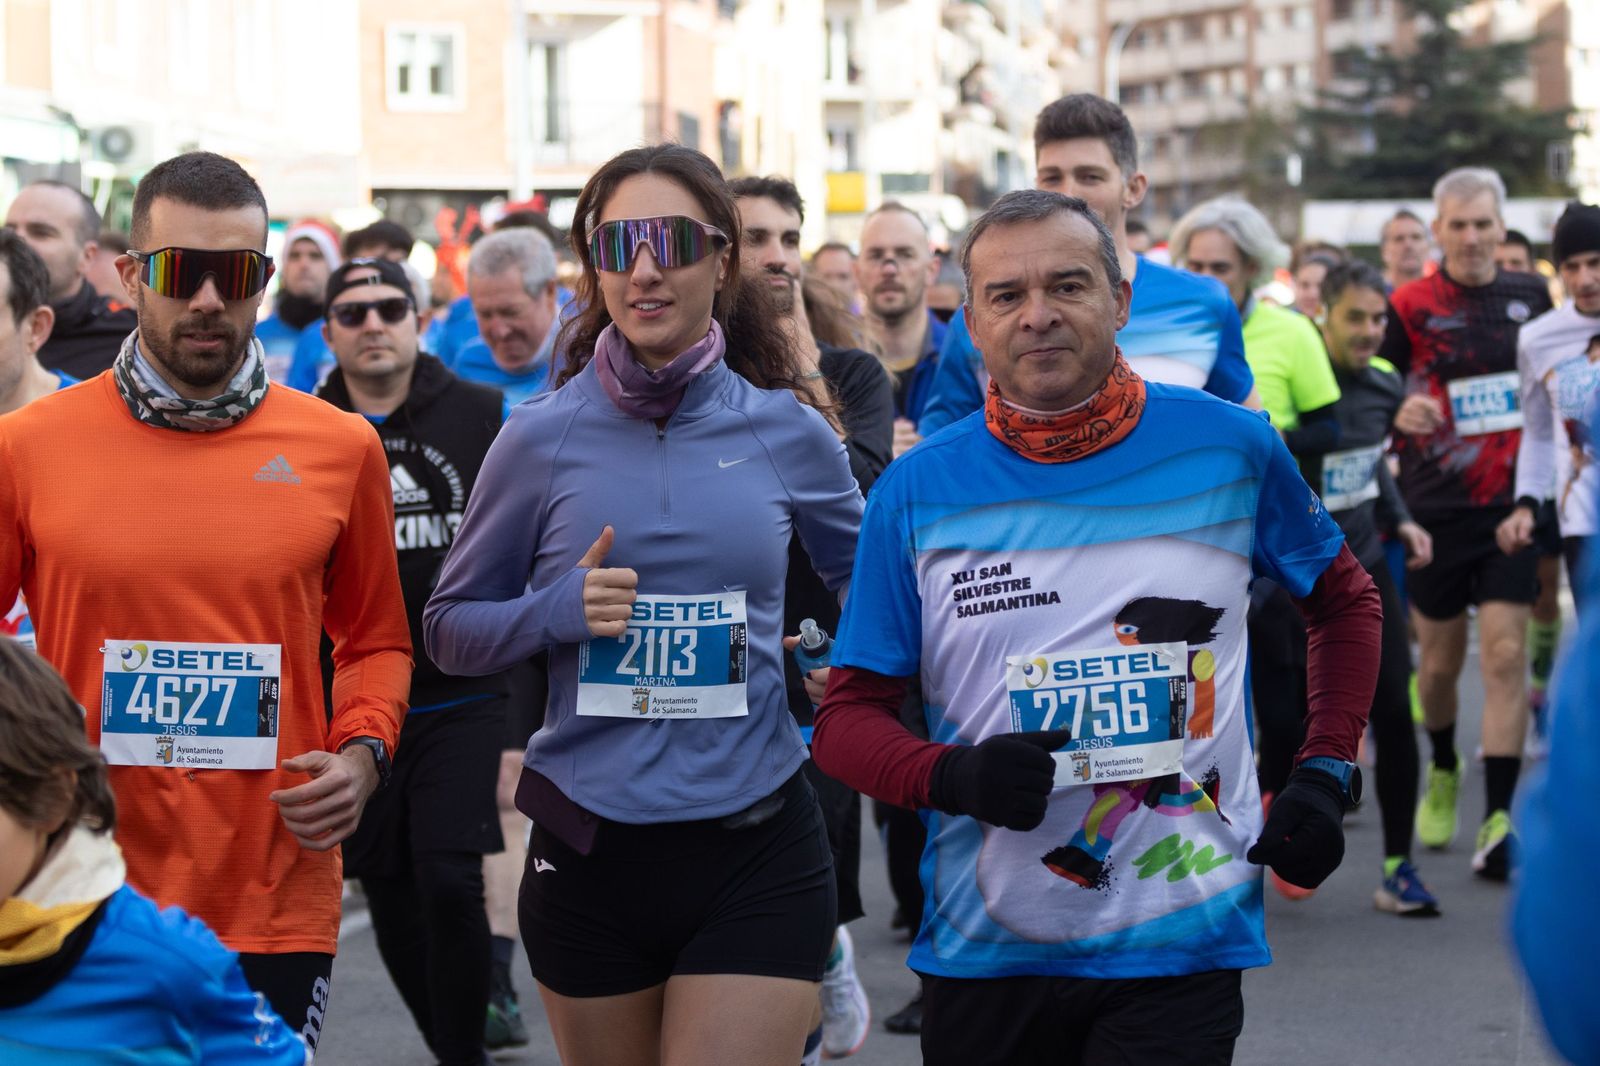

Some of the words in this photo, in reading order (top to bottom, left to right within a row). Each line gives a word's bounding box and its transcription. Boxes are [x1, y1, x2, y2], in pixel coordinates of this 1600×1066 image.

[253, 472, 302, 485] adidas
[951, 570, 975, 586] XLI
[979, 562, 1012, 580] SAN
[953, 577, 1031, 602] SILVESTRE
[632, 600, 732, 621] SETEL
[957, 591, 1061, 619] SALMANTINA
[616, 628, 698, 676] 2113
[152, 649, 264, 671] SETEL
[1053, 652, 1170, 681] SETEL
[634, 676, 677, 687] MARINA
[125, 674, 238, 726] 4627
[652, 696, 698, 706] Ayuntamiento
[652, 706, 660, 714] de
[662, 706, 698, 714] Salamanca
[1033, 681, 1149, 740] 2756
[162, 724, 198, 736] JESÚS
[1076, 736, 1113, 750] JESÚS
[176, 746, 224, 756] Ayuntamiento
[176, 755, 185, 763] de
[186, 756, 223, 765] Salamanca
[1094, 757, 1144, 769] Ayuntamiento
[1095, 770, 1105, 779] de
[1106, 767, 1144, 778] Salamanca
